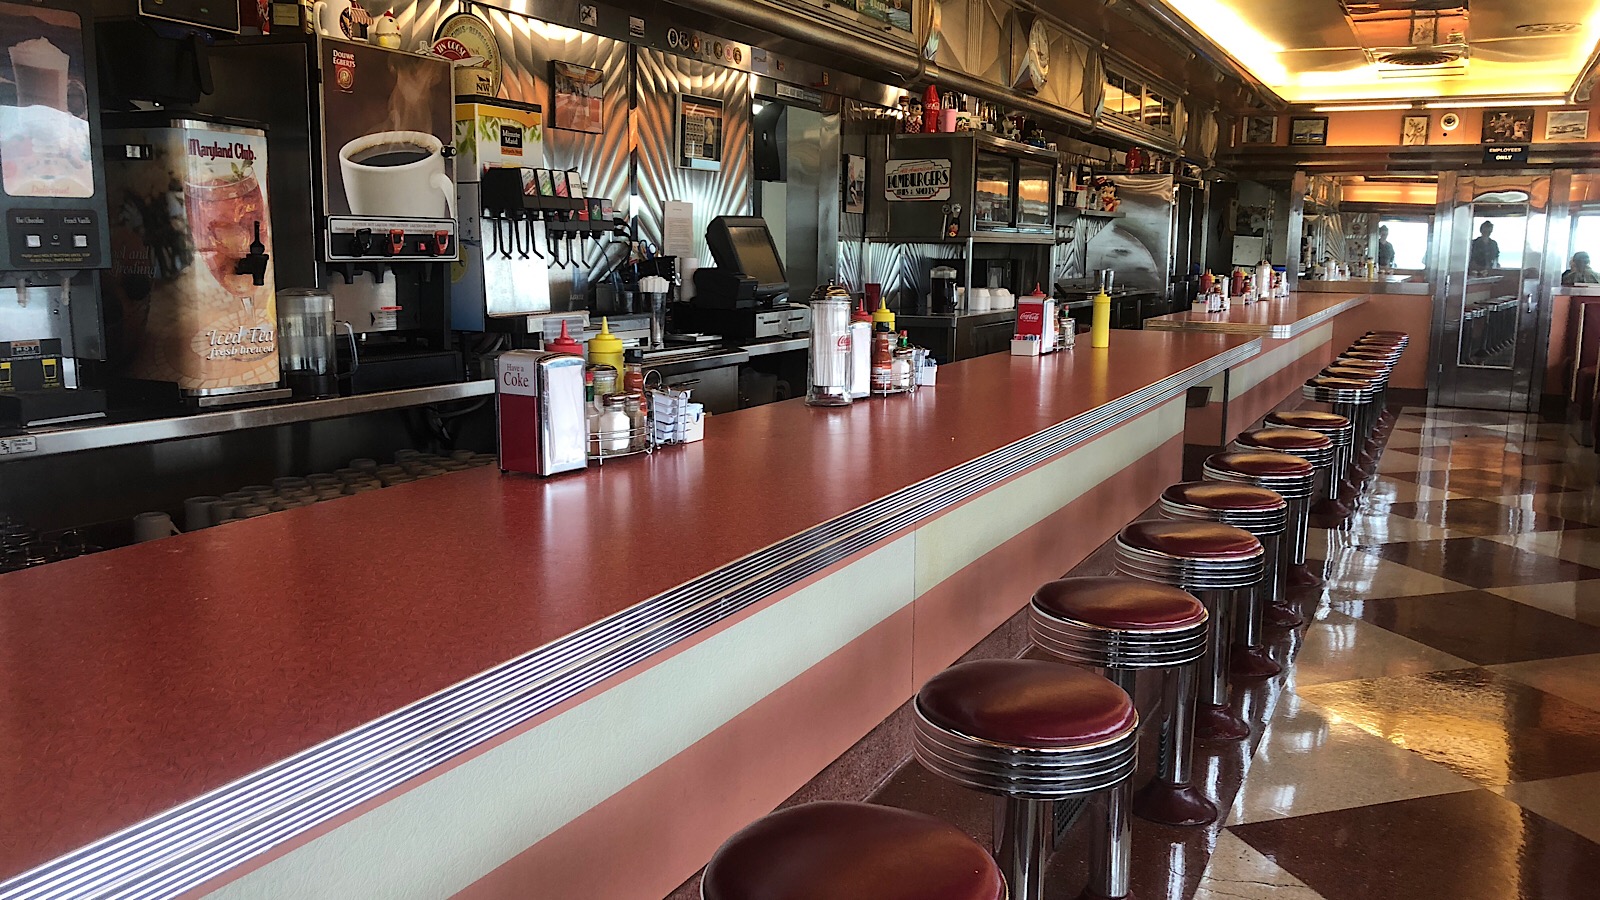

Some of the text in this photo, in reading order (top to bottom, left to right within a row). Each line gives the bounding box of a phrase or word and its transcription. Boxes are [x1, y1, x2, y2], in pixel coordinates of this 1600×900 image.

[475, 83, 491, 92] NW
[502, 129, 521, 139] Minute
[504, 136, 519, 145] Maid
[188, 138, 233, 161] Maryland
[128, 245, 149, 260] and
[1019, 311, 1040, 320] Coca-Cola
[206, 325, 274, 347] Iced Tea
[206, 343, 274, 361] fresh brewed
[506, 363, 520, 372] Have
[503, 371, 529, 388] Coke
